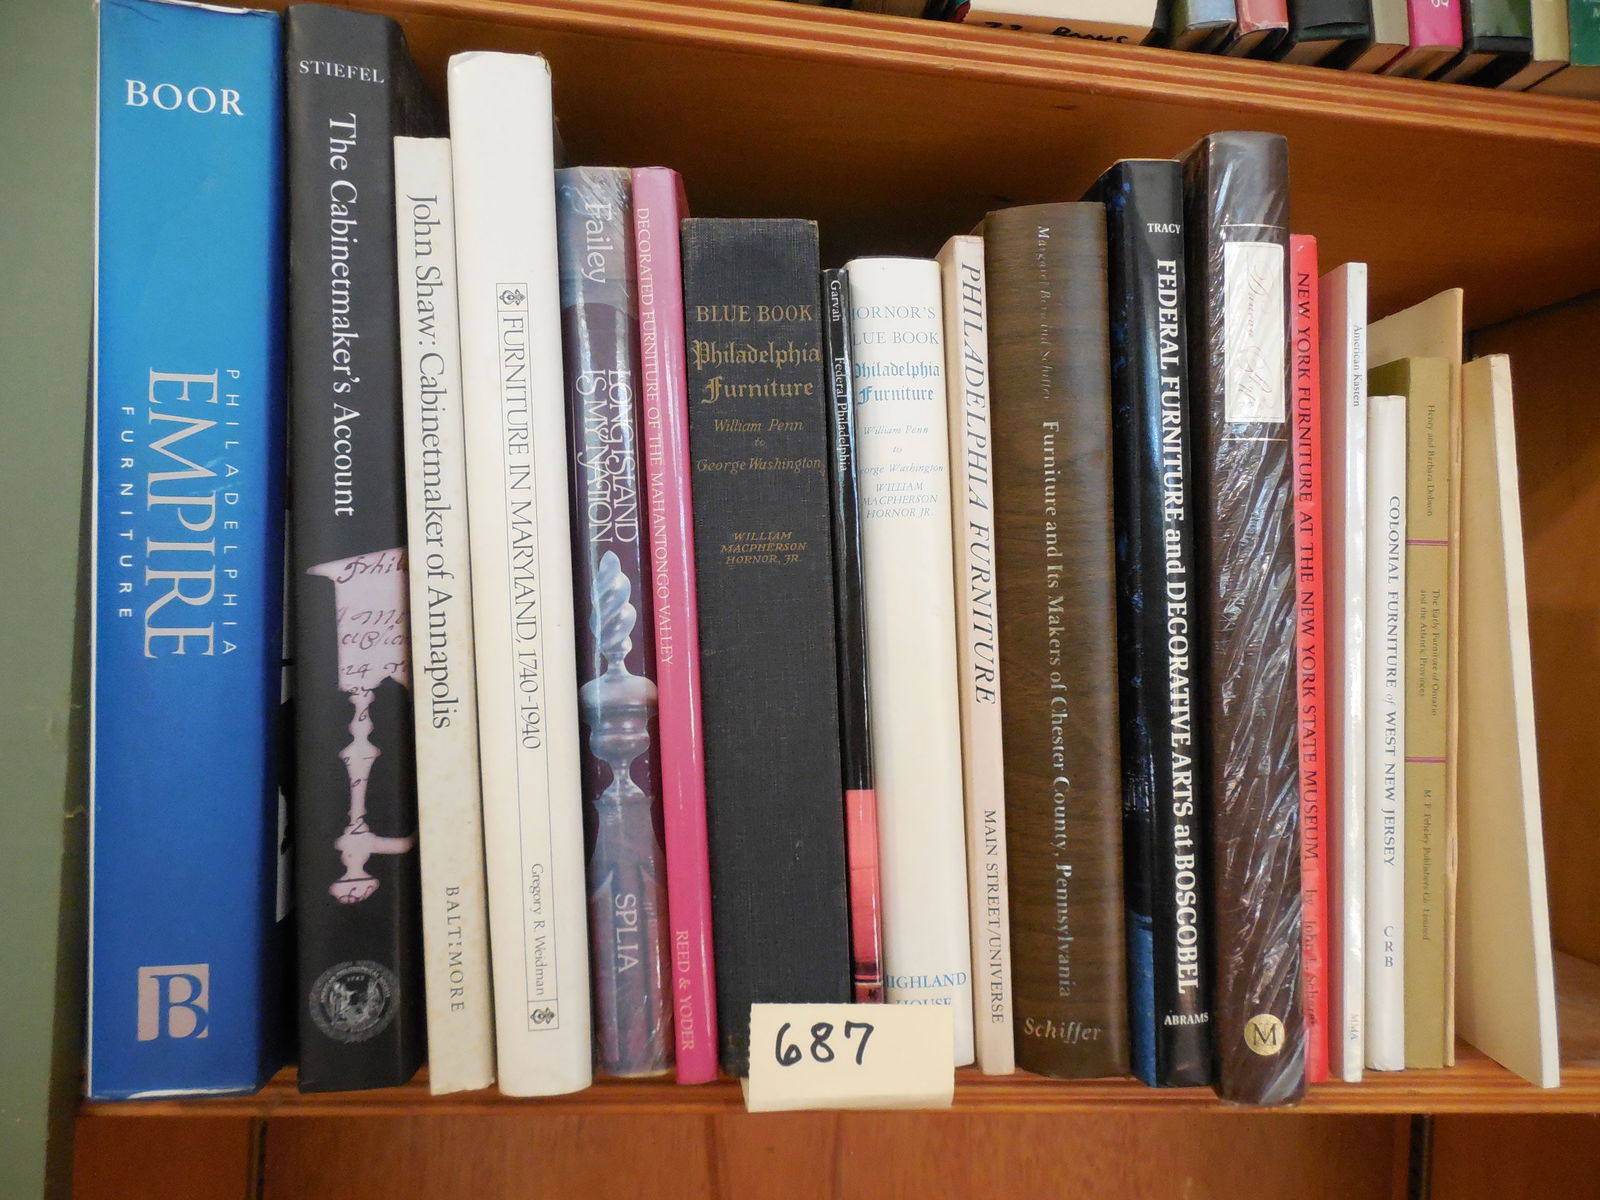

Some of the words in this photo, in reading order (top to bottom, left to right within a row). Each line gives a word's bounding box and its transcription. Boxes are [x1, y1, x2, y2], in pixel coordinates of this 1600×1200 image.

[299, 59, 385, 84] STIEFEL
[125, 79, 244, 116] BOOR
[330, 113, 357, 171] The
[406, 195, 441, 257] John
[581, 203, 614, 284] Failey
[1147, 223, 1181, 234] TRACY
[637, 208, 654, 306] DECORATED
[331, 179, 361, 394] Cabinetmaker's
[415, 265, 443, 346] Shaw:
[830, 280, 842, 322] Garvan
[1297, 273, 1310, 320] NEW
[696, 305, 751, 322] BLUE
[757, 304, 814, 322] BOOK
[1156, 259, 1179, 370] FEDERAL
[642, 312, 660, 401] FURNITURE
[692, 339, 821, 370] Philadelphia
[853, 331, 887, 345] LUE
[893, 331, 940, 345] BOOK
[1297, 328, 1311, 379] YORK
[1353, 325, 1363, 371] American
[503, 316, 530, 456] FURNITURE
[576, 369, 607, 396] IS
[701, 376, 814, 404] Furniture
[835, 357, 846, 397] Federal
[857, 385, 934, 405] Furniture
[962, 263, 988, 510] PHILADELPHIA
[1353, 374, 1363, 407] Kasten
[583, 400, 609, 443] MY
[608, 371, 634, 447] LONG
[647, 406, 661, 427] OF
[714, 418, 763, 434] William
[768, 419, 805, 432] Penn
[863, 424, 902, 435] William
[905, 424, 929, 434] Penn
[1426, 405, 1436, 430] Henry
[332, 404, 361, 517] Account
[419, 353, 452, 547] Cabinetmaker
[649, 433, 663, 465] THE
[754, 437, 766, 448] to
[837, 403, 849, 472] Philadelphia
[1161, 376, 1184, 522] FURNITURE
[1298, 387, 1313, 502] FURNITURE
[510, 464, 531, 491] IN
[697, 458, 746, 475] George
[749, 457, 822, 475] Washington
[860, 466, 884, 477] eorge
[889, 463, 944, 474] Washington
[876, 482, 923, 493] WILLIAM
[1043, 421, 1061, 517] Furniture
[118, 406, 135, 618] FURNITURE
[144, 366, 219, 659] EMPIRE
[222, 369, 241, 654] PHILADELPHIA
[577, 443, 614, 543] NATION
[604, 448, 638, 543] ISLAND
[862, 495, 939, 506] MACPHERSON
[866, 508, 917, 519] HORNOR
[651, 473, 669, 603] MAHANTONGO
[720, 542, 807, 553] MACPHERSON
[733, 531, 792, 541] WILLIAM
[1046, 522, 1064, 559] and
[1300, 512, 1314, 536] AT
[1387, 496, 1400, 584] COLONIAL
[426, 553, 455, 579] of
[511, 500, 538, 643] MARYLAND,
[1046, 564, 1064, 589] Its
[1165, 529, 1186, 577] and
[1301, 542, 1315, 582] THE
[658, 604, 673, 666] VALLEY
[970, 521, 996, 706] FURNITURE
[1047, 596, 1066, 666] Makers
[1301, 591, 1316, 637] NEW
[424, 586, 459, 729] Annapolis
[1385, 591, 1399, 688] FURNITURE
[1050, 671, 1068, 693] of
[1166, 581, 1192, 747] DECORATIVE
[1301, 645, 1317, 697] YORK
[517, 651, 541, 750] 1740-1940
[1384, 693, 1394, 706] of
[1051, 697, 1070, 771] Chester
[1303, 705, 1318, 762] STATE
[1384, 711, 1396, 756] WEST
[1170, 751, 1194, 818] ARTS
[1383, 763, 1396, 801] NEW
[984, 810, 998, 856] MAIN
[1051, 776, 1071, 858] County,
[1173, 824, 1194, 849] at
[1303, 770, 1320, 860] MUSEUM
[1381, 808, 1395, 866] JERSEY
[530, 863, 544, 916] Gregory
[533, 920, 545, 932] R.
[615, 894, 639, 973] SPLIA
[986, 863, 1004, 1024] STREET/UNIVERSE
[1054, 863, 1077, 998] Pennsylvania
[1174, 854, 1199, 995] BOSCOBEL
[535, 935, 549, 997] Weidman
[676, 930, 691, 972] REED
[150, 972, 209, 1040] B
[679, 977, 688, 988] &
[679, 995, 695, 1051] YODER
[1024, 1017, 1102, 1044] Schiffer
[1164, 1012, 1209, 1027] ABRAMS
[1253, 1022, 1278, 1046] M
[774, 1021, 875, 1067] 687
